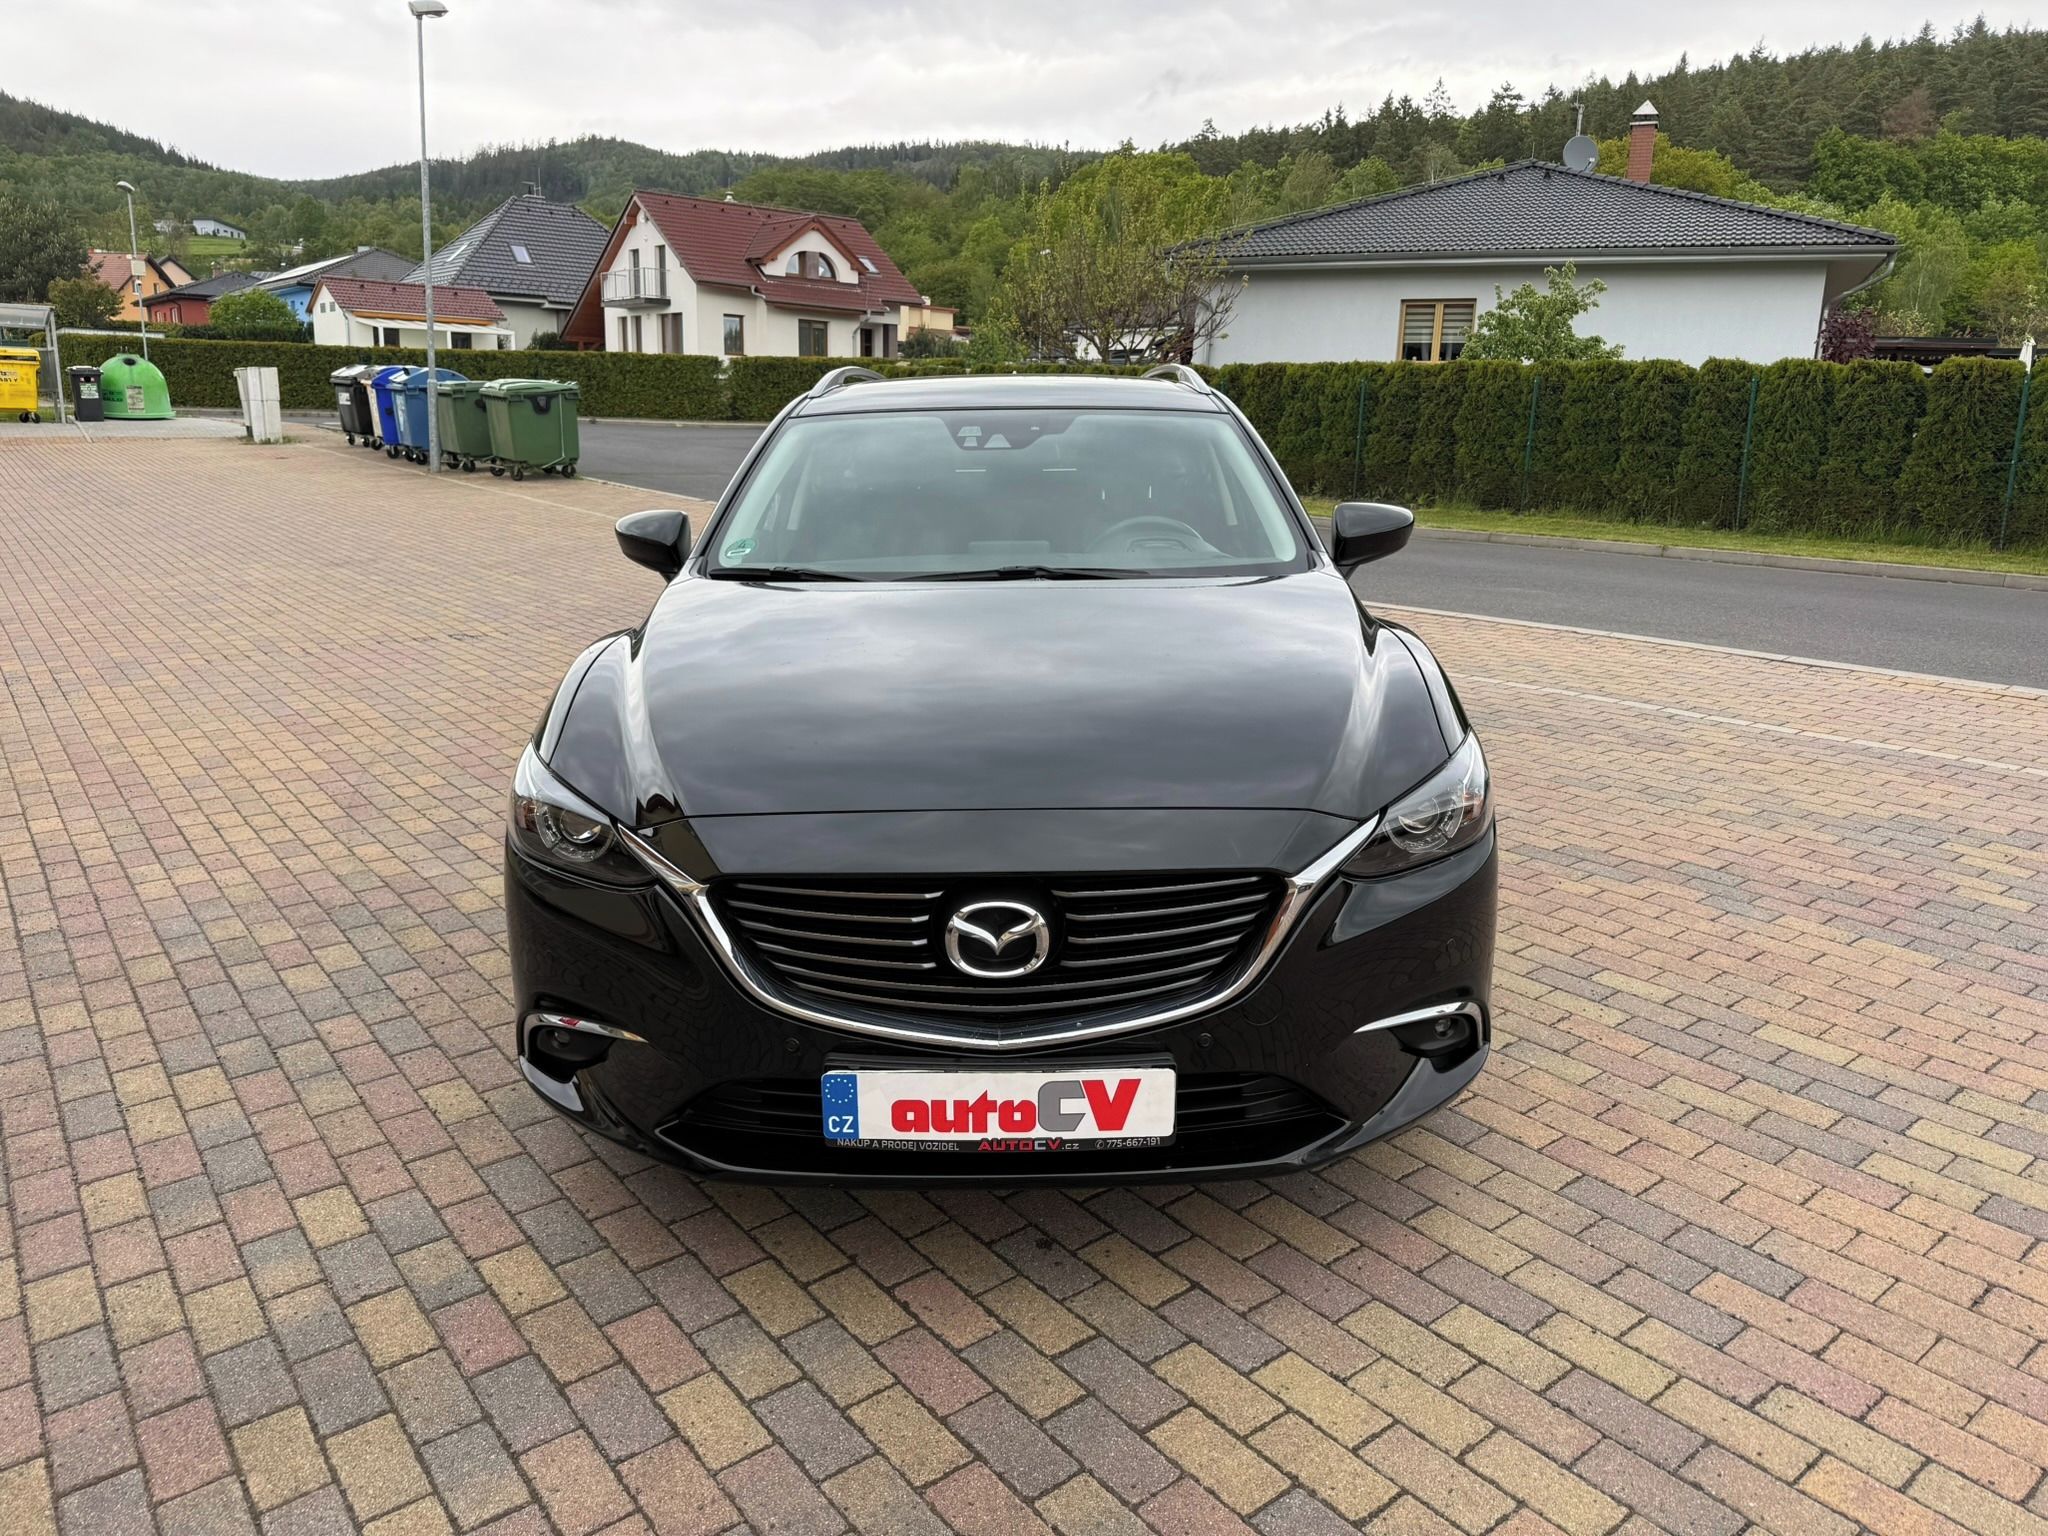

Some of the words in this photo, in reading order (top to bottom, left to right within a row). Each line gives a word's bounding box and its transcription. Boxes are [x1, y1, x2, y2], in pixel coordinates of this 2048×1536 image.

[891, 1078, 1142, 1133] autoCV
[828, 1116, 854, 1134] CZ
[872, 1140, 880, 1149] A
[881, 1140, 917, 1151] PRODEJ
[919, 1141, 960, 1151] VOZIDEL
[1106, 1137, 1161, 1149] 775-667-191
